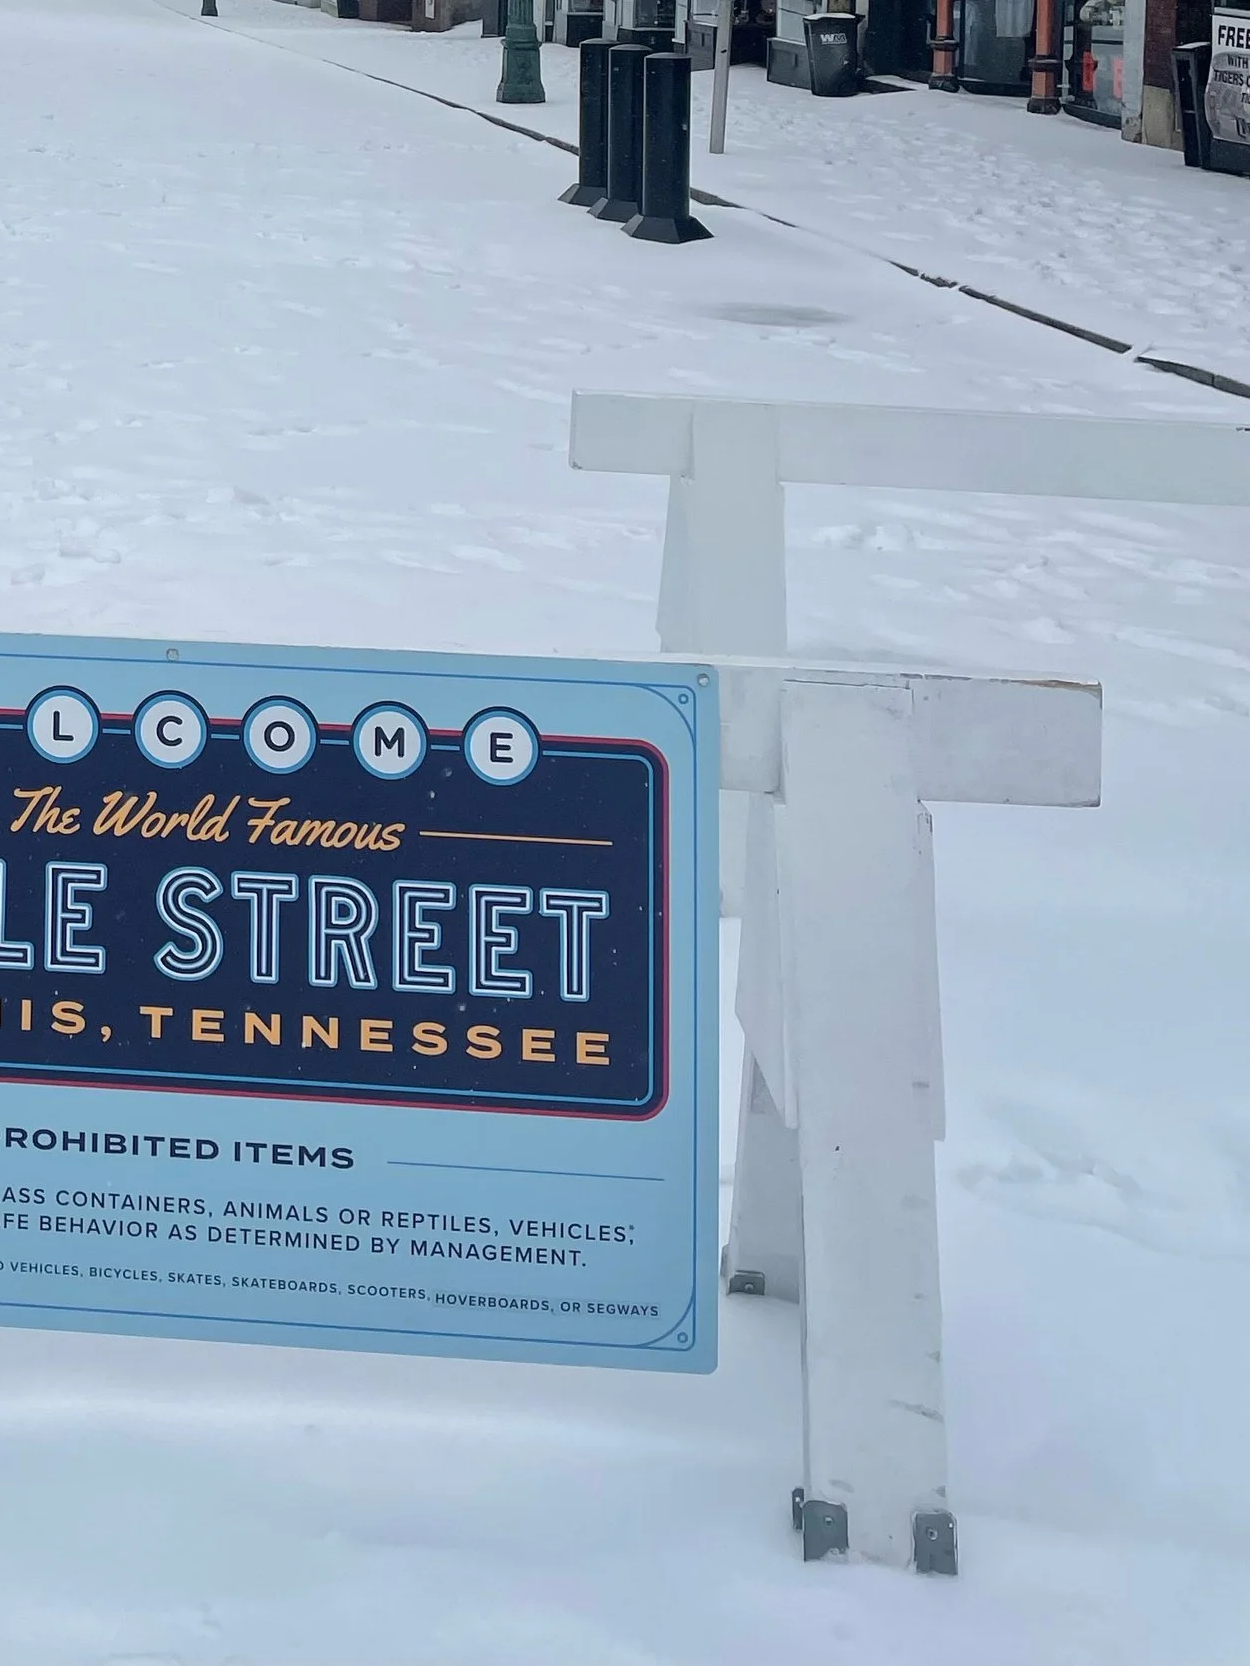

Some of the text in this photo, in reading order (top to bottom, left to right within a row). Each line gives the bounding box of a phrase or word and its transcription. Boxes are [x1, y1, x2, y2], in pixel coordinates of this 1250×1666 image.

[1213, 69, 1244, 87] TIGERS
[10, 786, 81, 834] The
[93, 791, 241, 843] World
[246, 796, 406, 852] Famous
[153, 866, 610, 1002] STREET
[140, 1006, 610, 1065] TENNESSEE
[234, 1142, 354, 1169] ITEMS
[56, 1190, 212, 1218] CONTAINERS,
[223, 1201, 328, 1223] ANIMALS
[339, 1208, 370, 1226] OR
[382, 1211, 498, 1237] REPTILES,
[40, 1215, 157, 1238] BEHAVIOR
[168, 1224, 196, 1240] AS
[208, 1226, 359, 1251] DETERMINED
[371, 1237, 400, 1254] BY
[411, 1240, 586, 1267] MANAGEMENT.
[10, 1262, 83, 1277] VEHICLES,
[90, 1267, 162, 1282] BICYCLES,
[168, 1272, 226, 1287] SKATES,
[232, 1277, 341, 1295] SKATEBOARDS,
[348, 1285, 430, 1301] SCOOTERS,
[436, 1293, 554, 1313] HOVERBOARDS,
[560, 1302, 580, 1313] OR
[587, 1303, 658, 1316] SEGWAYS
